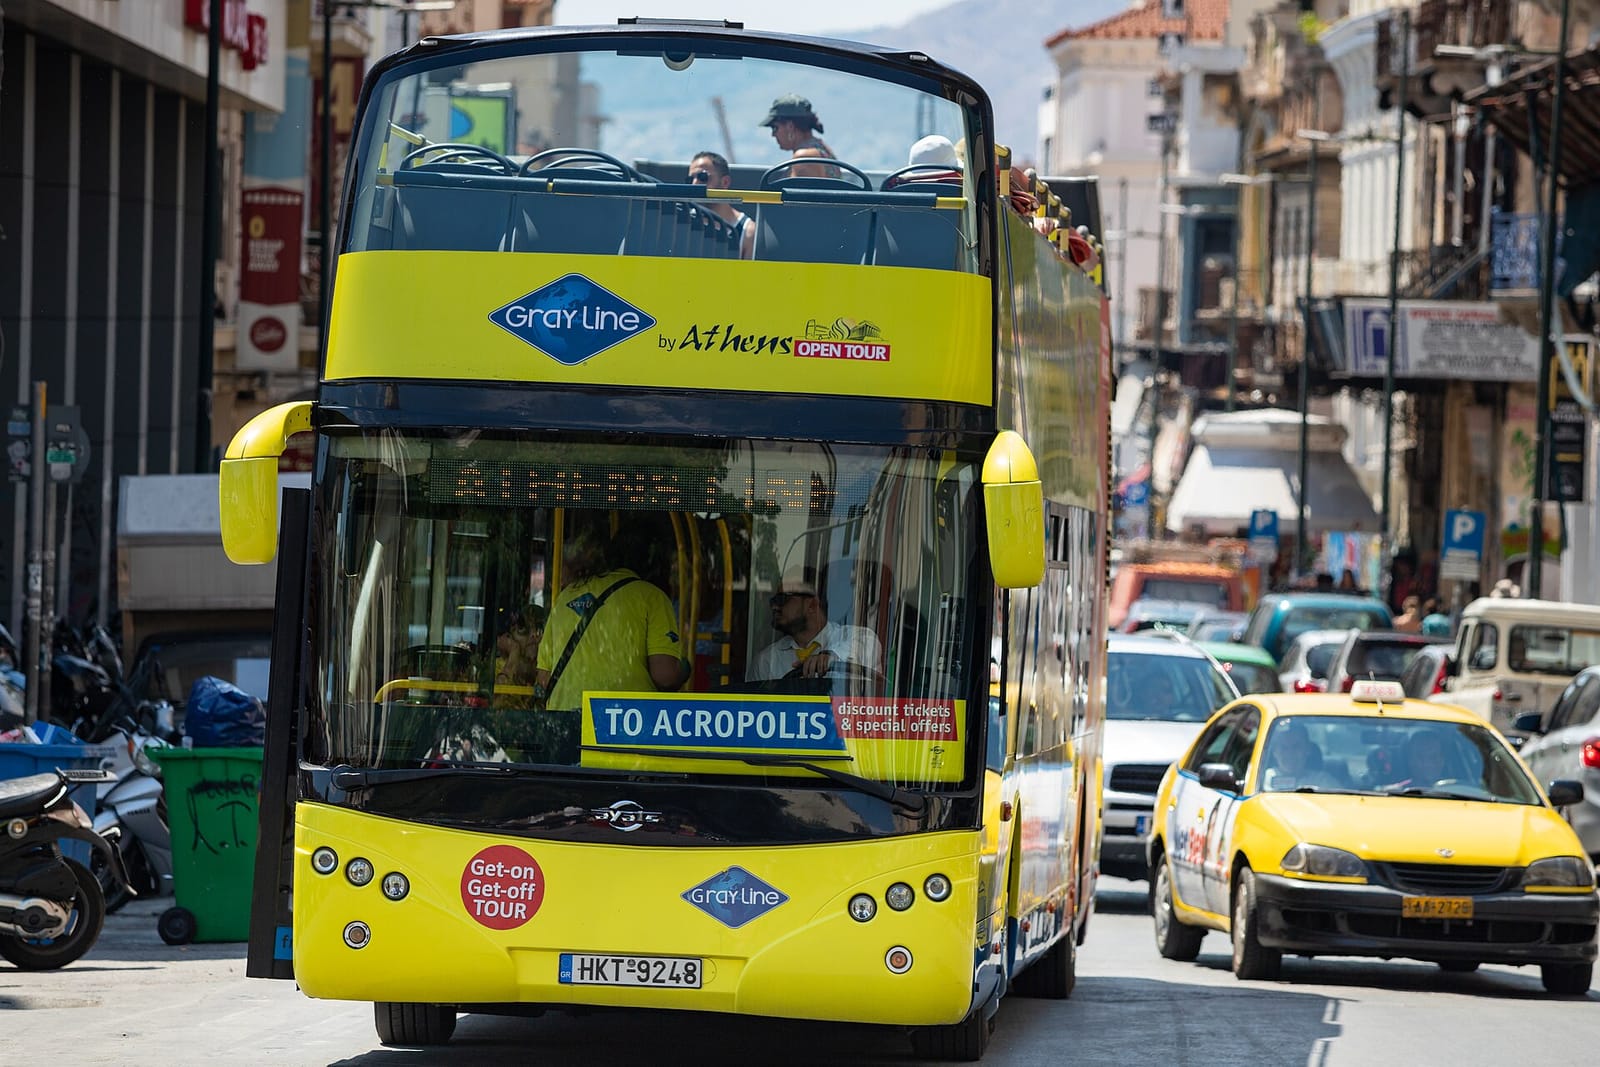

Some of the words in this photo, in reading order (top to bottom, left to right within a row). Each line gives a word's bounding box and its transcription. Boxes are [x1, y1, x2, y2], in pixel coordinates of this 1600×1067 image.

[583, 306, 640, 331] Line
[658, 334, 677, 352] by
[679, 324, 793, 356] Athens
[797, 341, 842, 358] OPEN
[844, 343, 887, 360] TOUR
[1452, 513, 1476, 542] P
[838, 702, 899, 716] discount
[903, 703, 951, 717] tickets
[605, 708, 643, 737] TO
[652, 709, 827, 740] ACROPOLIS
[841, 717, 852, 731] &
[856, 718, 906, 734] special
[910, 719, 951, 733] offers
[470, 859, 535, 880] Get-on
[467, 878, 536, 901] Get-off
[741, 887, 779, 905] Line
[473, 899, 527, 920] TOUR
